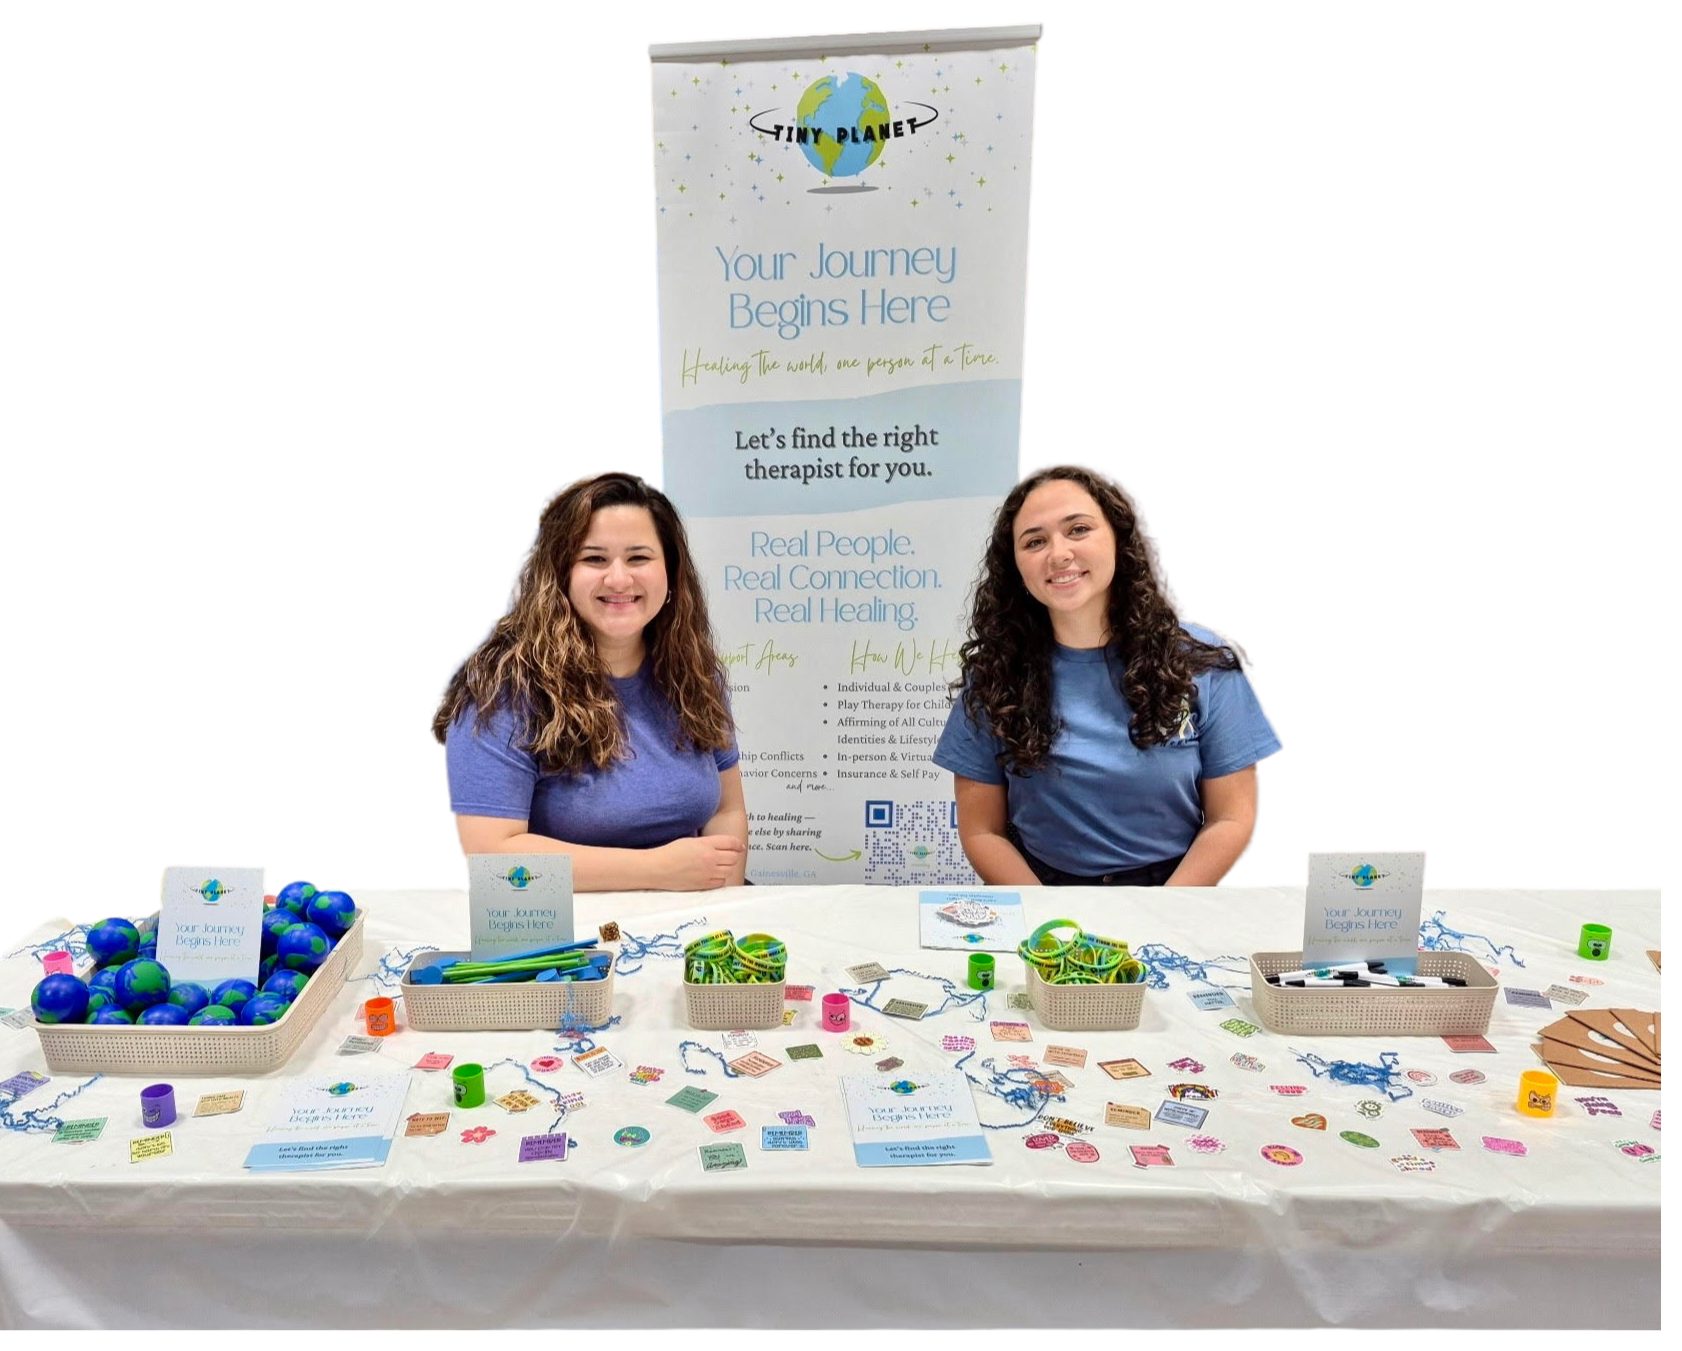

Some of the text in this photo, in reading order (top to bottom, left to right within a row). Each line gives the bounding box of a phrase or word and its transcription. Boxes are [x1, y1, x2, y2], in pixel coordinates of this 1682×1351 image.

[773, 117, 918, 145] TINY PLANET
[715, 243, 957, 284] Your Journey
[729, 288, 951, 341] Begins Here
[681, 346, 752, 388] Healing
[836, 358, 861, 370] one
[867, 356, 914, 377] person
[920, 344, 944, 373] at
[943, 353, 955, 365] a
[791, 426, 837, 450] find
[841, 425, 879, 449] the
[882, 424, 940, 454] right
[744, 455, 933, 486] therapist for you.
[751, 528, 916, 564] Real People.
[724, 563, 943, 592] Real Connection.
[754, 596, 920, 632] Real Healing.
[755, 638, 799, 676] Areas
[850, 638, 889, 675] How
[894, 637, 924, 676] We
[837, 681, 947, 695] Individual & Couples
[837, 699, 860, 712] Play
[861, 699, 904, 713] Therapy
[906, 699, 921, 710] for
[837, 717, 946, 730] Affirming of All Cultu
[837, 734, 886, 745] Identities
[888, 734, 898, 745] &
[760, 751, 805, 761] Conflicts
[837, 752, 933, 764] In-person & Virtua
[771, 768, 818, 779] Concerns
[837, 769, 940, 782] Insurance & Self Pay
[786, 779, 803, 794] and
[757, 814, 766, 822] to
[768, 813, 803, 824] healing
[755, 828, 772, 836] else
[773, 828, 785, 839] by
[786, 828, 822, 839] sharing
[766, 843, 788, 851] Scan
[789, 842, 812, 852] here.
[803, 869, 817, 879] GA
[487, 907, 556, 919] Your Journey
[1324, 907, 1402, 920] Your Journey
[175, 922, 245, 936] Your Journey
[488, 920, 554, 933] Begins Here
[1325, 919, 1398, 933] Begins Here
[175, 935, 211, 950] Begins
